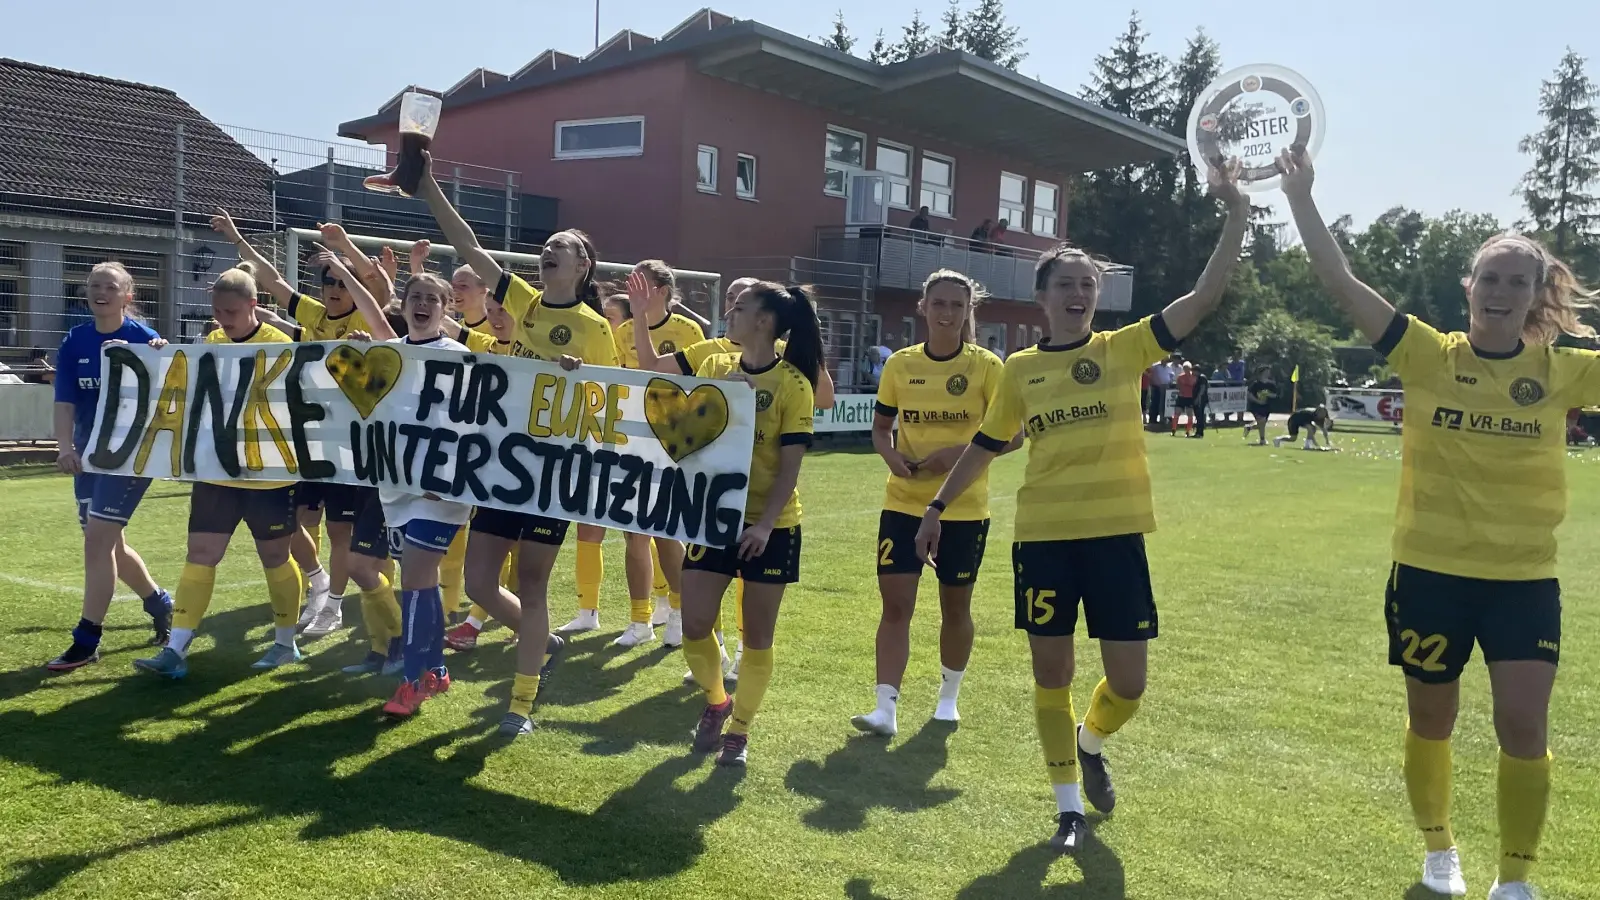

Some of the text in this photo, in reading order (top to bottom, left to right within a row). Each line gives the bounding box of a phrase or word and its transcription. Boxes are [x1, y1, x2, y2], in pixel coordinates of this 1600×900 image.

[1243, 142, 1272, 158] 2023
[88, 344, 630, 478] DANKE FÜR EURE
[922, 409, 969, 421] VR-Bank
[1045, 400, 1108, 424] VR-Bank
[1469, 412, 1542, 435] VR-Bank
[350, 420, 748, 546] UNTERSTÜTZUNG
[533, 526, 552, 536] JAKO
[763, 568, 782, 576] JAKO
[1025, 587, 1057, 625] 15
[1400, 628, 1448, 671] 22
